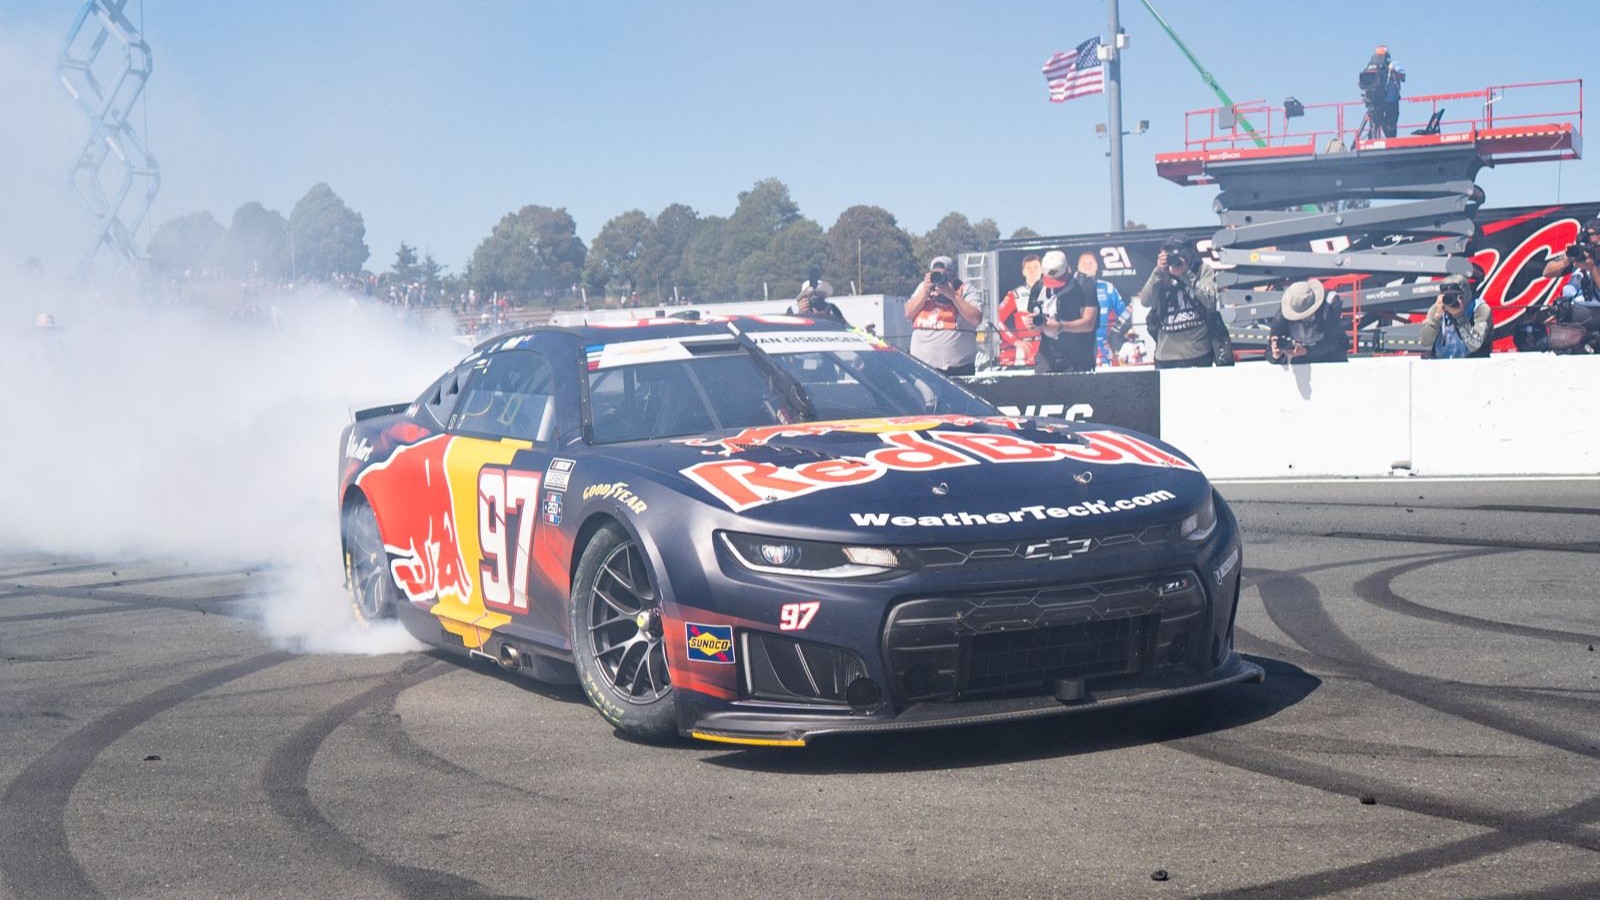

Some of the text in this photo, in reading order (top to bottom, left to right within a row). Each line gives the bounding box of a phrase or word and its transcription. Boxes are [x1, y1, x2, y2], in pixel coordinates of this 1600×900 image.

[1099, 246, 1132, 270] 21
[784, 336, 863, 344] GISBERGEN
[582, 482, 648, 515] GOODYEAR
[478, 467, 543, 615] 97
[779, 601, 821, 632] 97
[690, 638, 729, 651] SUNOCO
